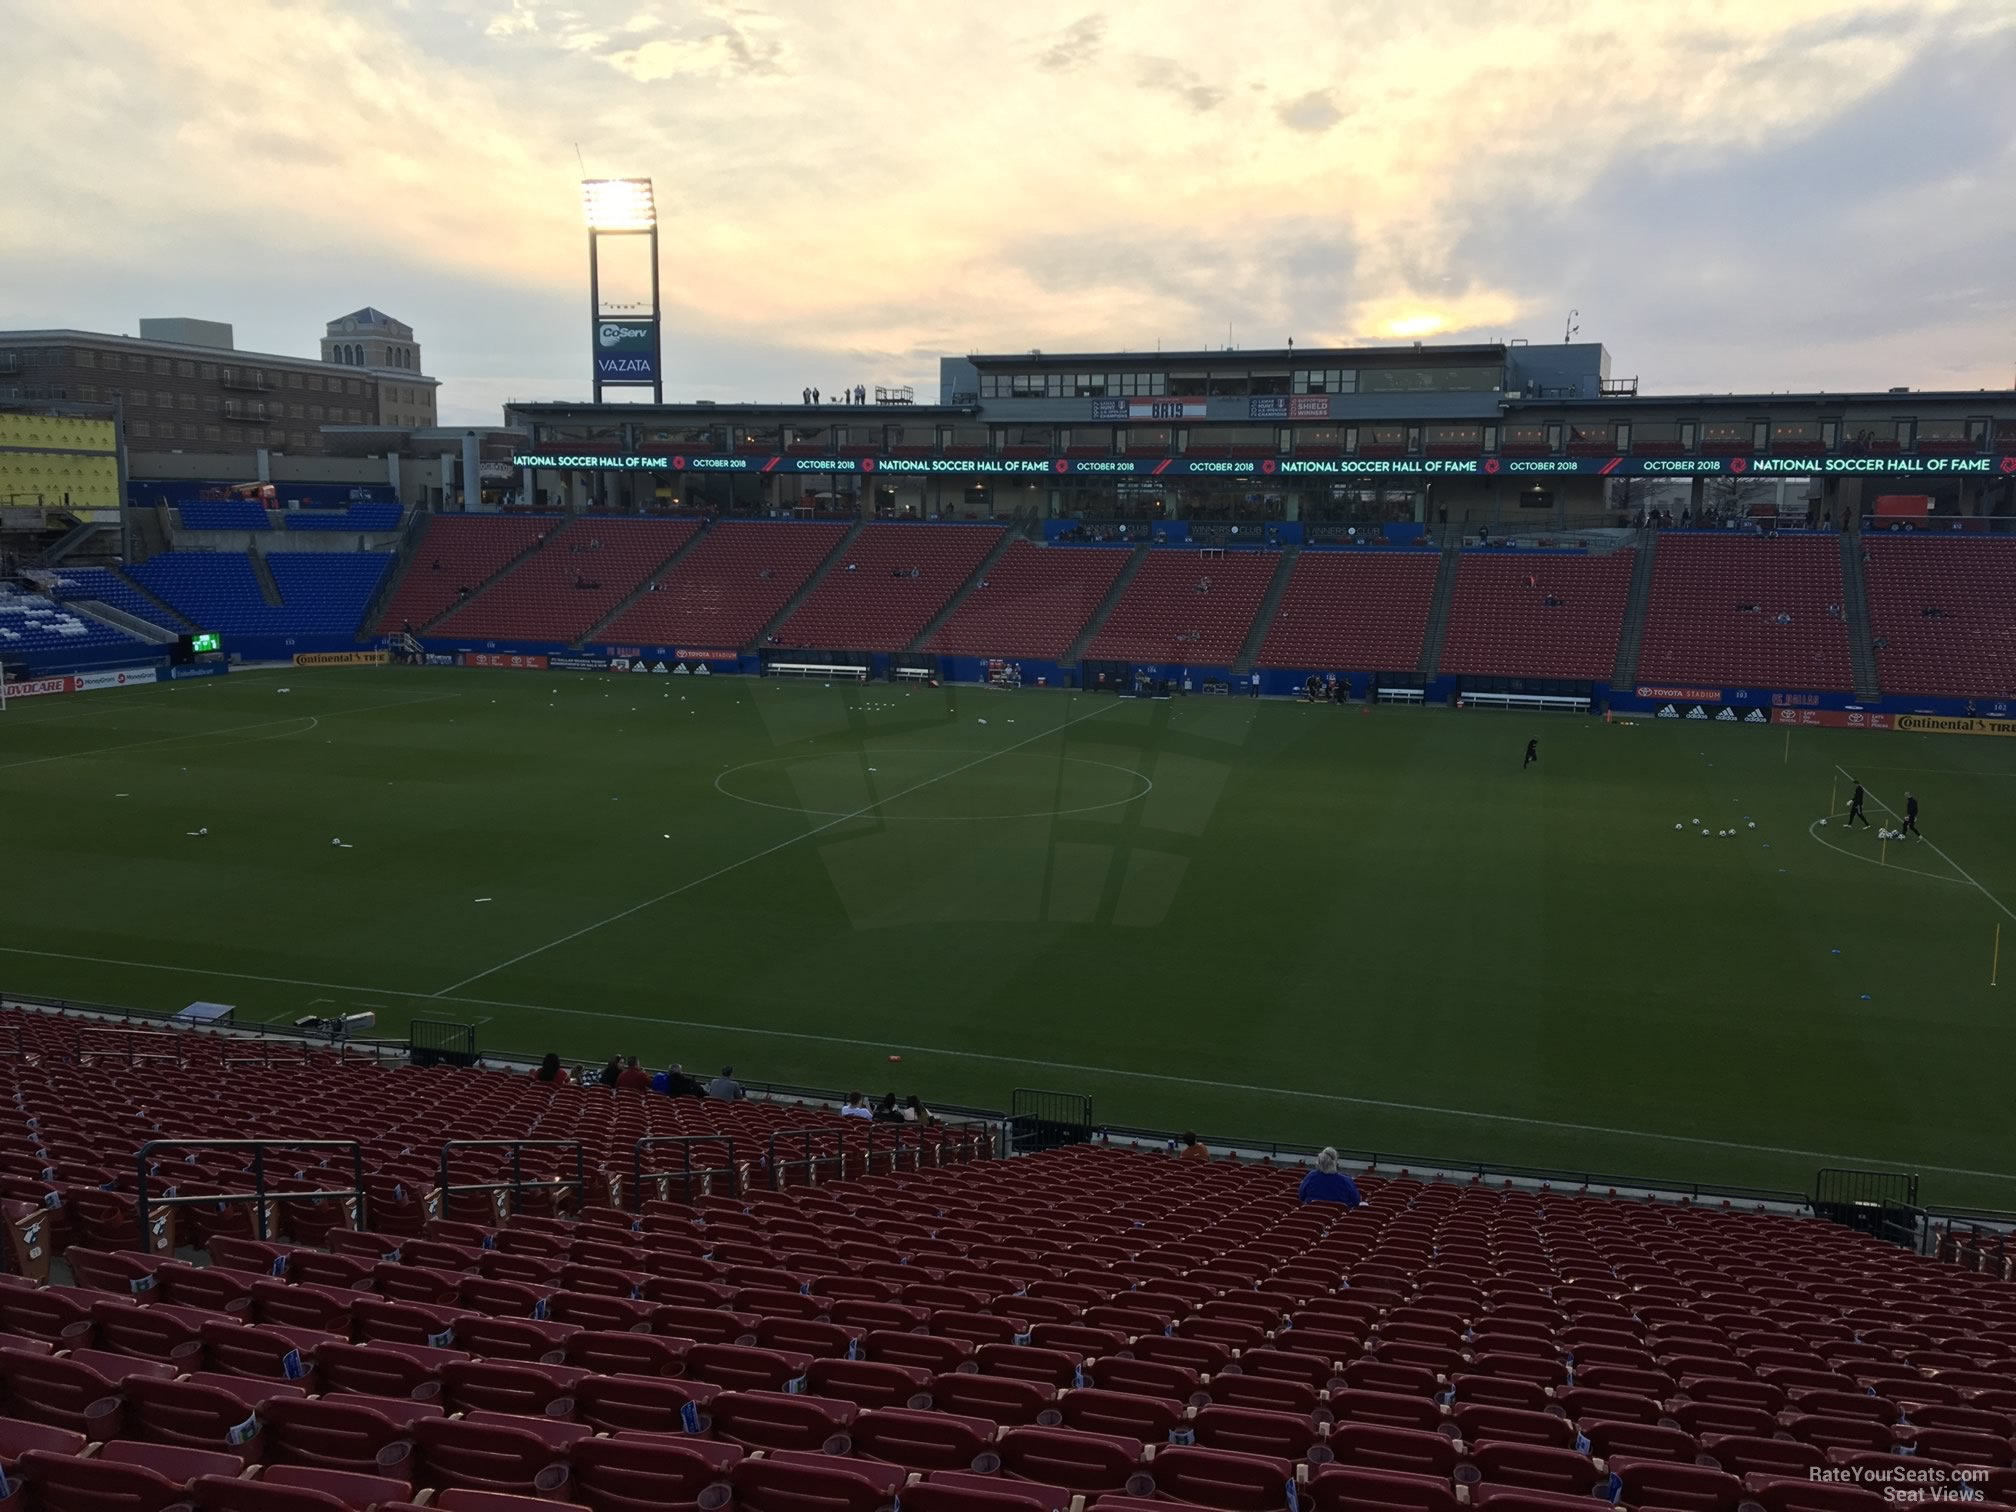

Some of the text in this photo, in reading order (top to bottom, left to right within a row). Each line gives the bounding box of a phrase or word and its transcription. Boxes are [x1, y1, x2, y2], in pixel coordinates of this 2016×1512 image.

[603, 328, 647, 338] CoServ
[598, 359, 651, 372] VAZATA
[558, 457, 598, 467] SOCCER
[599, 457, 624, 467] HALL
[625, 457, 640, 467] OF
[642, 458, 667, 468] FAME
[693, 459, 746, 468] OCTOBER 2018
[796, 460, 855, 470] OCTOBER 2018
[879, 460, 1049, 472] NATIONAL SOCCER HALL OF FAME
[1077, 462, 1134, 471] OCTOBER 2018
[1190, 462, 1254, 472] OCTOBER 2018
[1281, 460, 1477, 472] NATIONAL SOCCER HALL OF FAME
[1510, 461, 1578, 471] OCTOBER 2018
[1643, 461, 1721, 470] OCTOBER 2018
[1753, 459, 1990, 471] NATIONAL SOCCER HALL OF FAME
[1192, 526, 1262, 534] WINNERS CLUB
[296, 654, 352, 665] Continental
[85, 676, 115, 685] MoneyGram
[126, 672, 155, 681] MoneyGram
[1686, 690, 1721, 698] STADIUM
[1898, 716, 2016, 732] Continental TIRE
